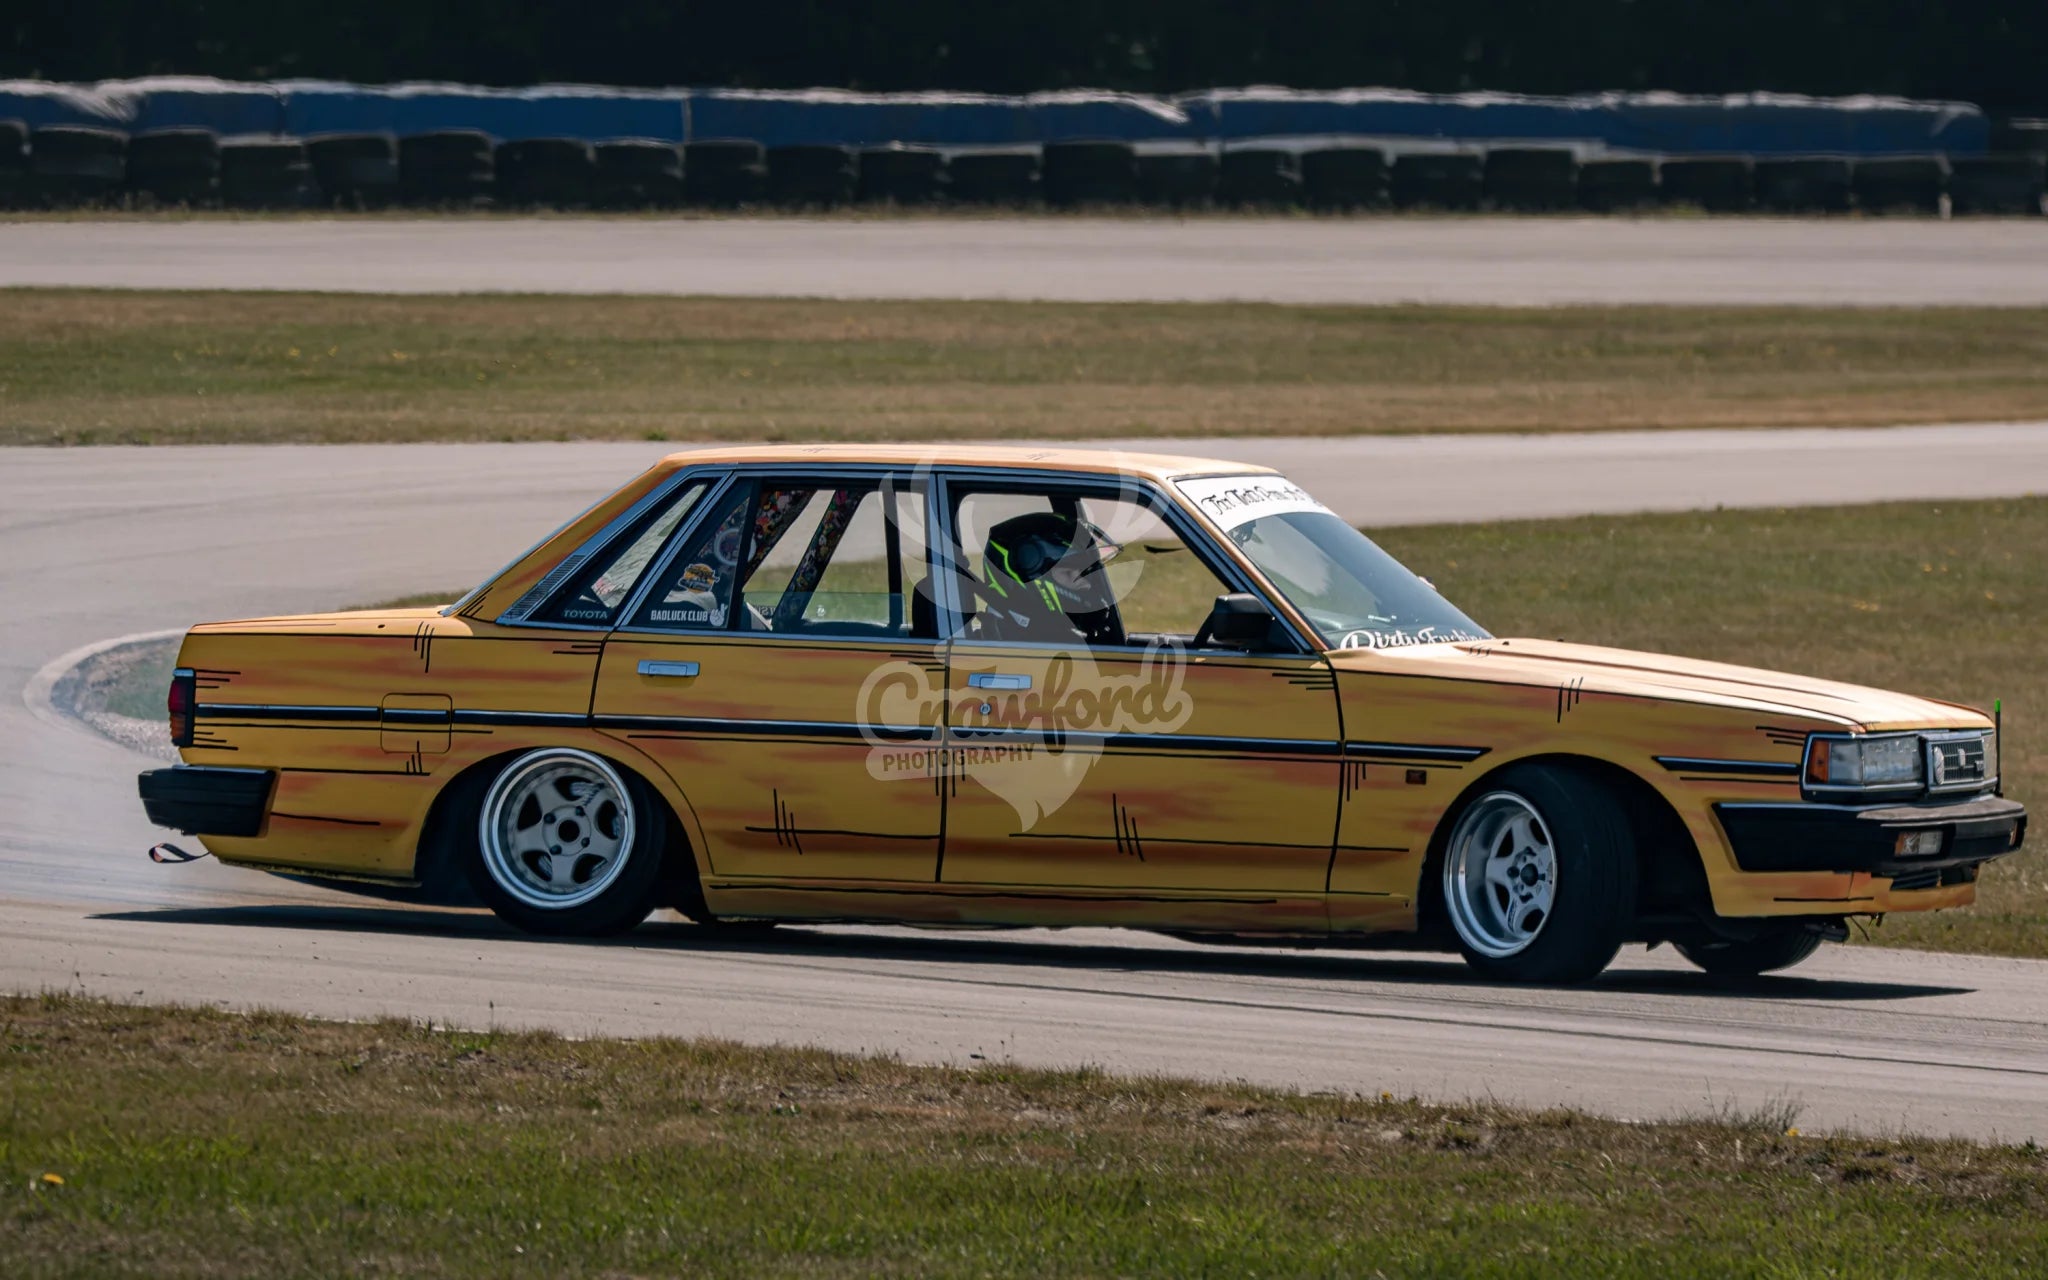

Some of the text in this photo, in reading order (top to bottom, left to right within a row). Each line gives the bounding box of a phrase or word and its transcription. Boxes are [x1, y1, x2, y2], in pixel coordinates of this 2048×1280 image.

[563, 609, 608, 619] TOYOTA
[650, 609, 708, 621] BADLUCK CLUB
